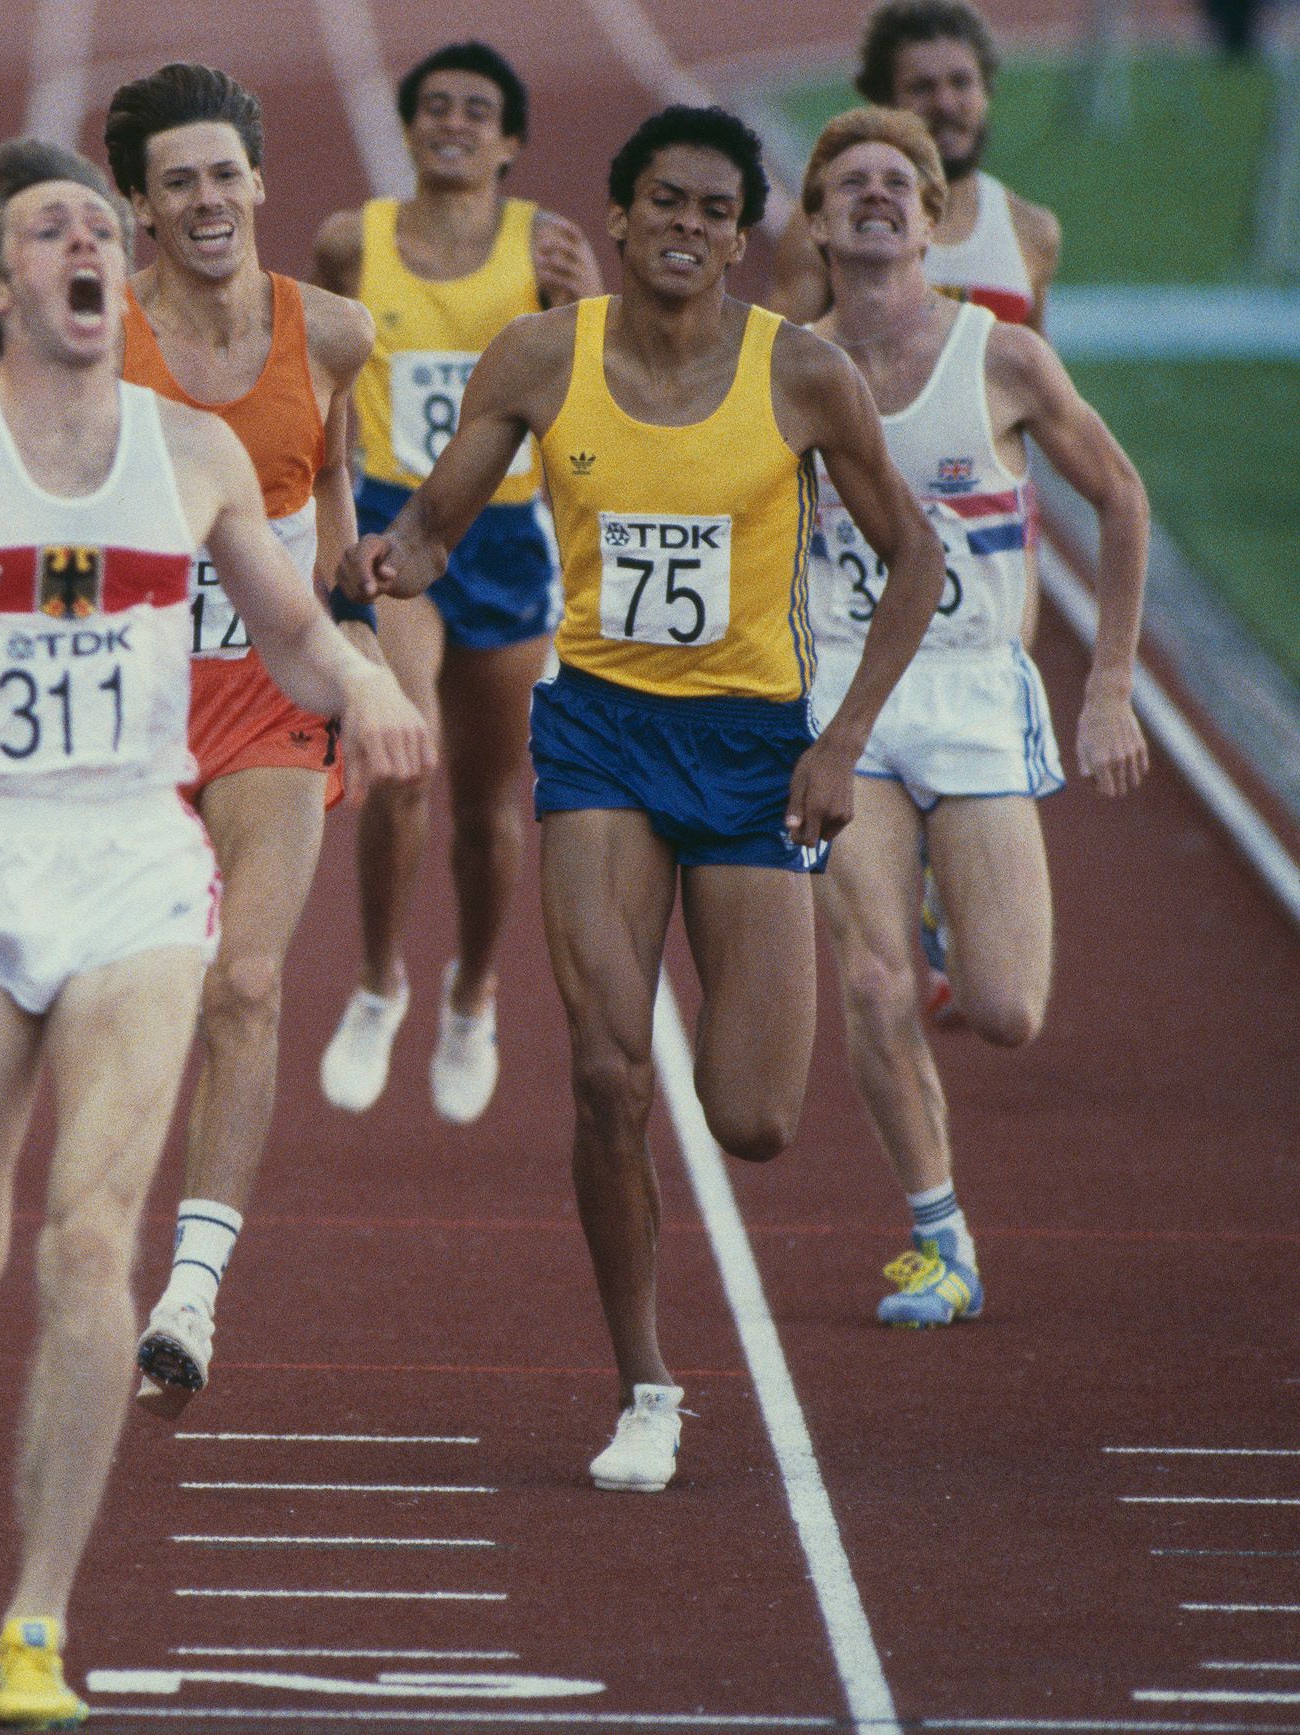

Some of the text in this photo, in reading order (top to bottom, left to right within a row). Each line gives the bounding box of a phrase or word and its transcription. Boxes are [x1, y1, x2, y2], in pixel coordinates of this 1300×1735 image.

[423, 392, 457, 464] 8
[627, 523, 721, 549] TDK
[616, 556, 706, 644] 75
[35, 623, 133, 658] TDK
